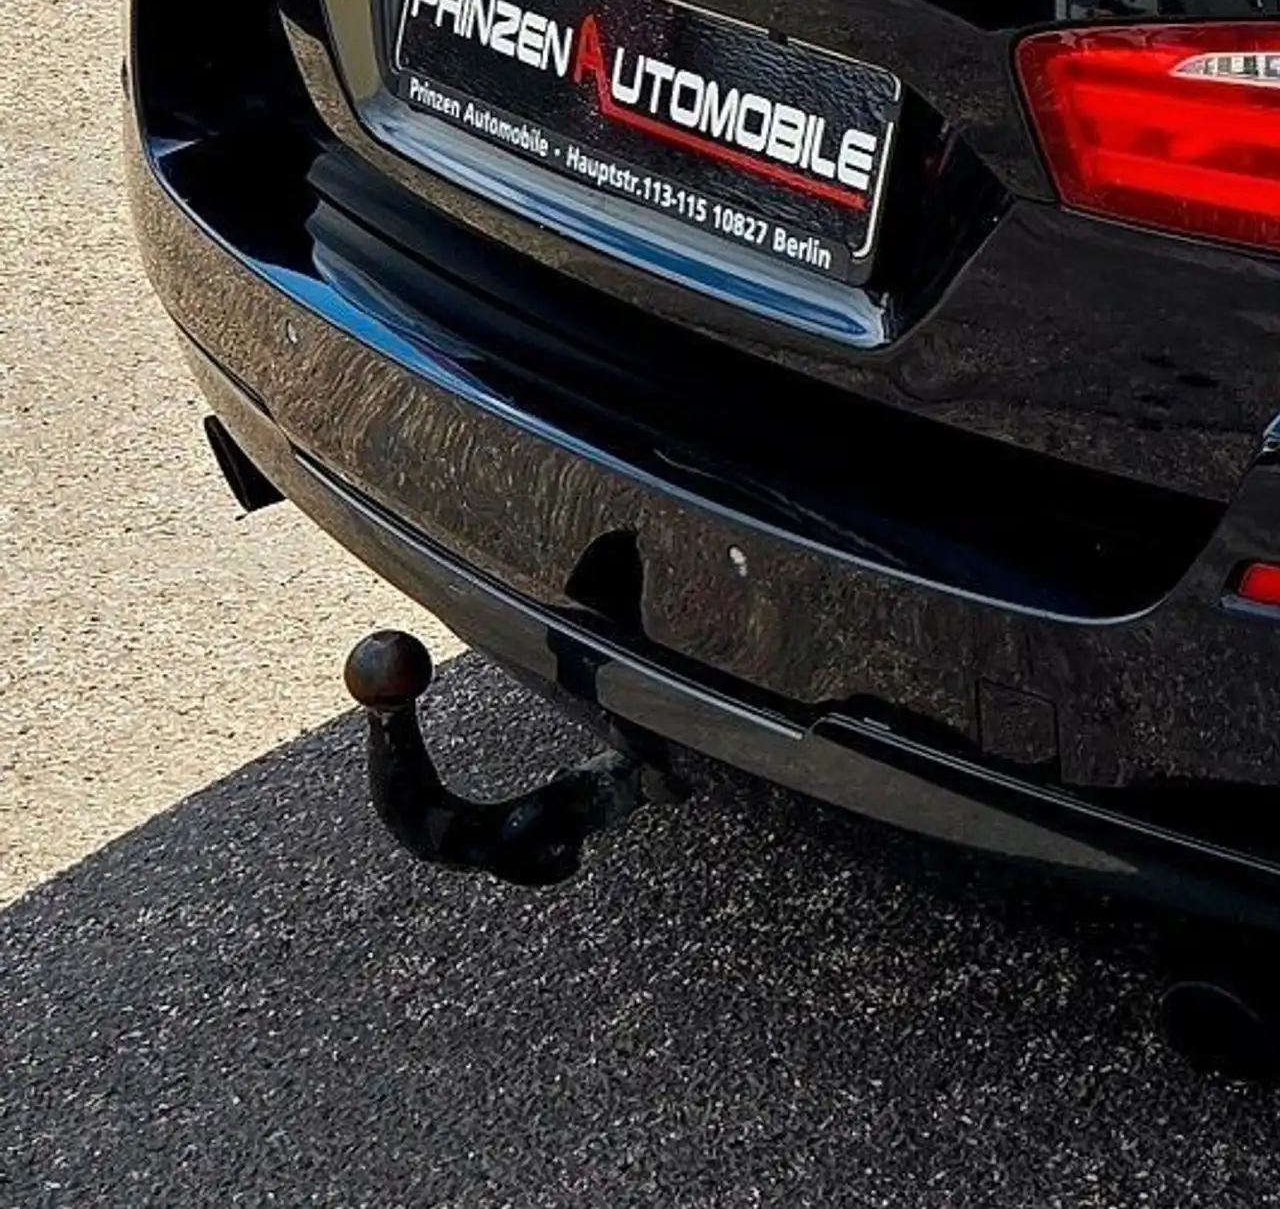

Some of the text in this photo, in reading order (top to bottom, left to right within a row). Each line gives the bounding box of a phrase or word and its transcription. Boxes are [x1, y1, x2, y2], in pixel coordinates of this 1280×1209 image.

[409, 78, 460, 121] Prinzen
[461, 101, 549, 159] Automobile
[712, 206, 768, 245] 10827
[772, 227, 832, 270] Berlin
